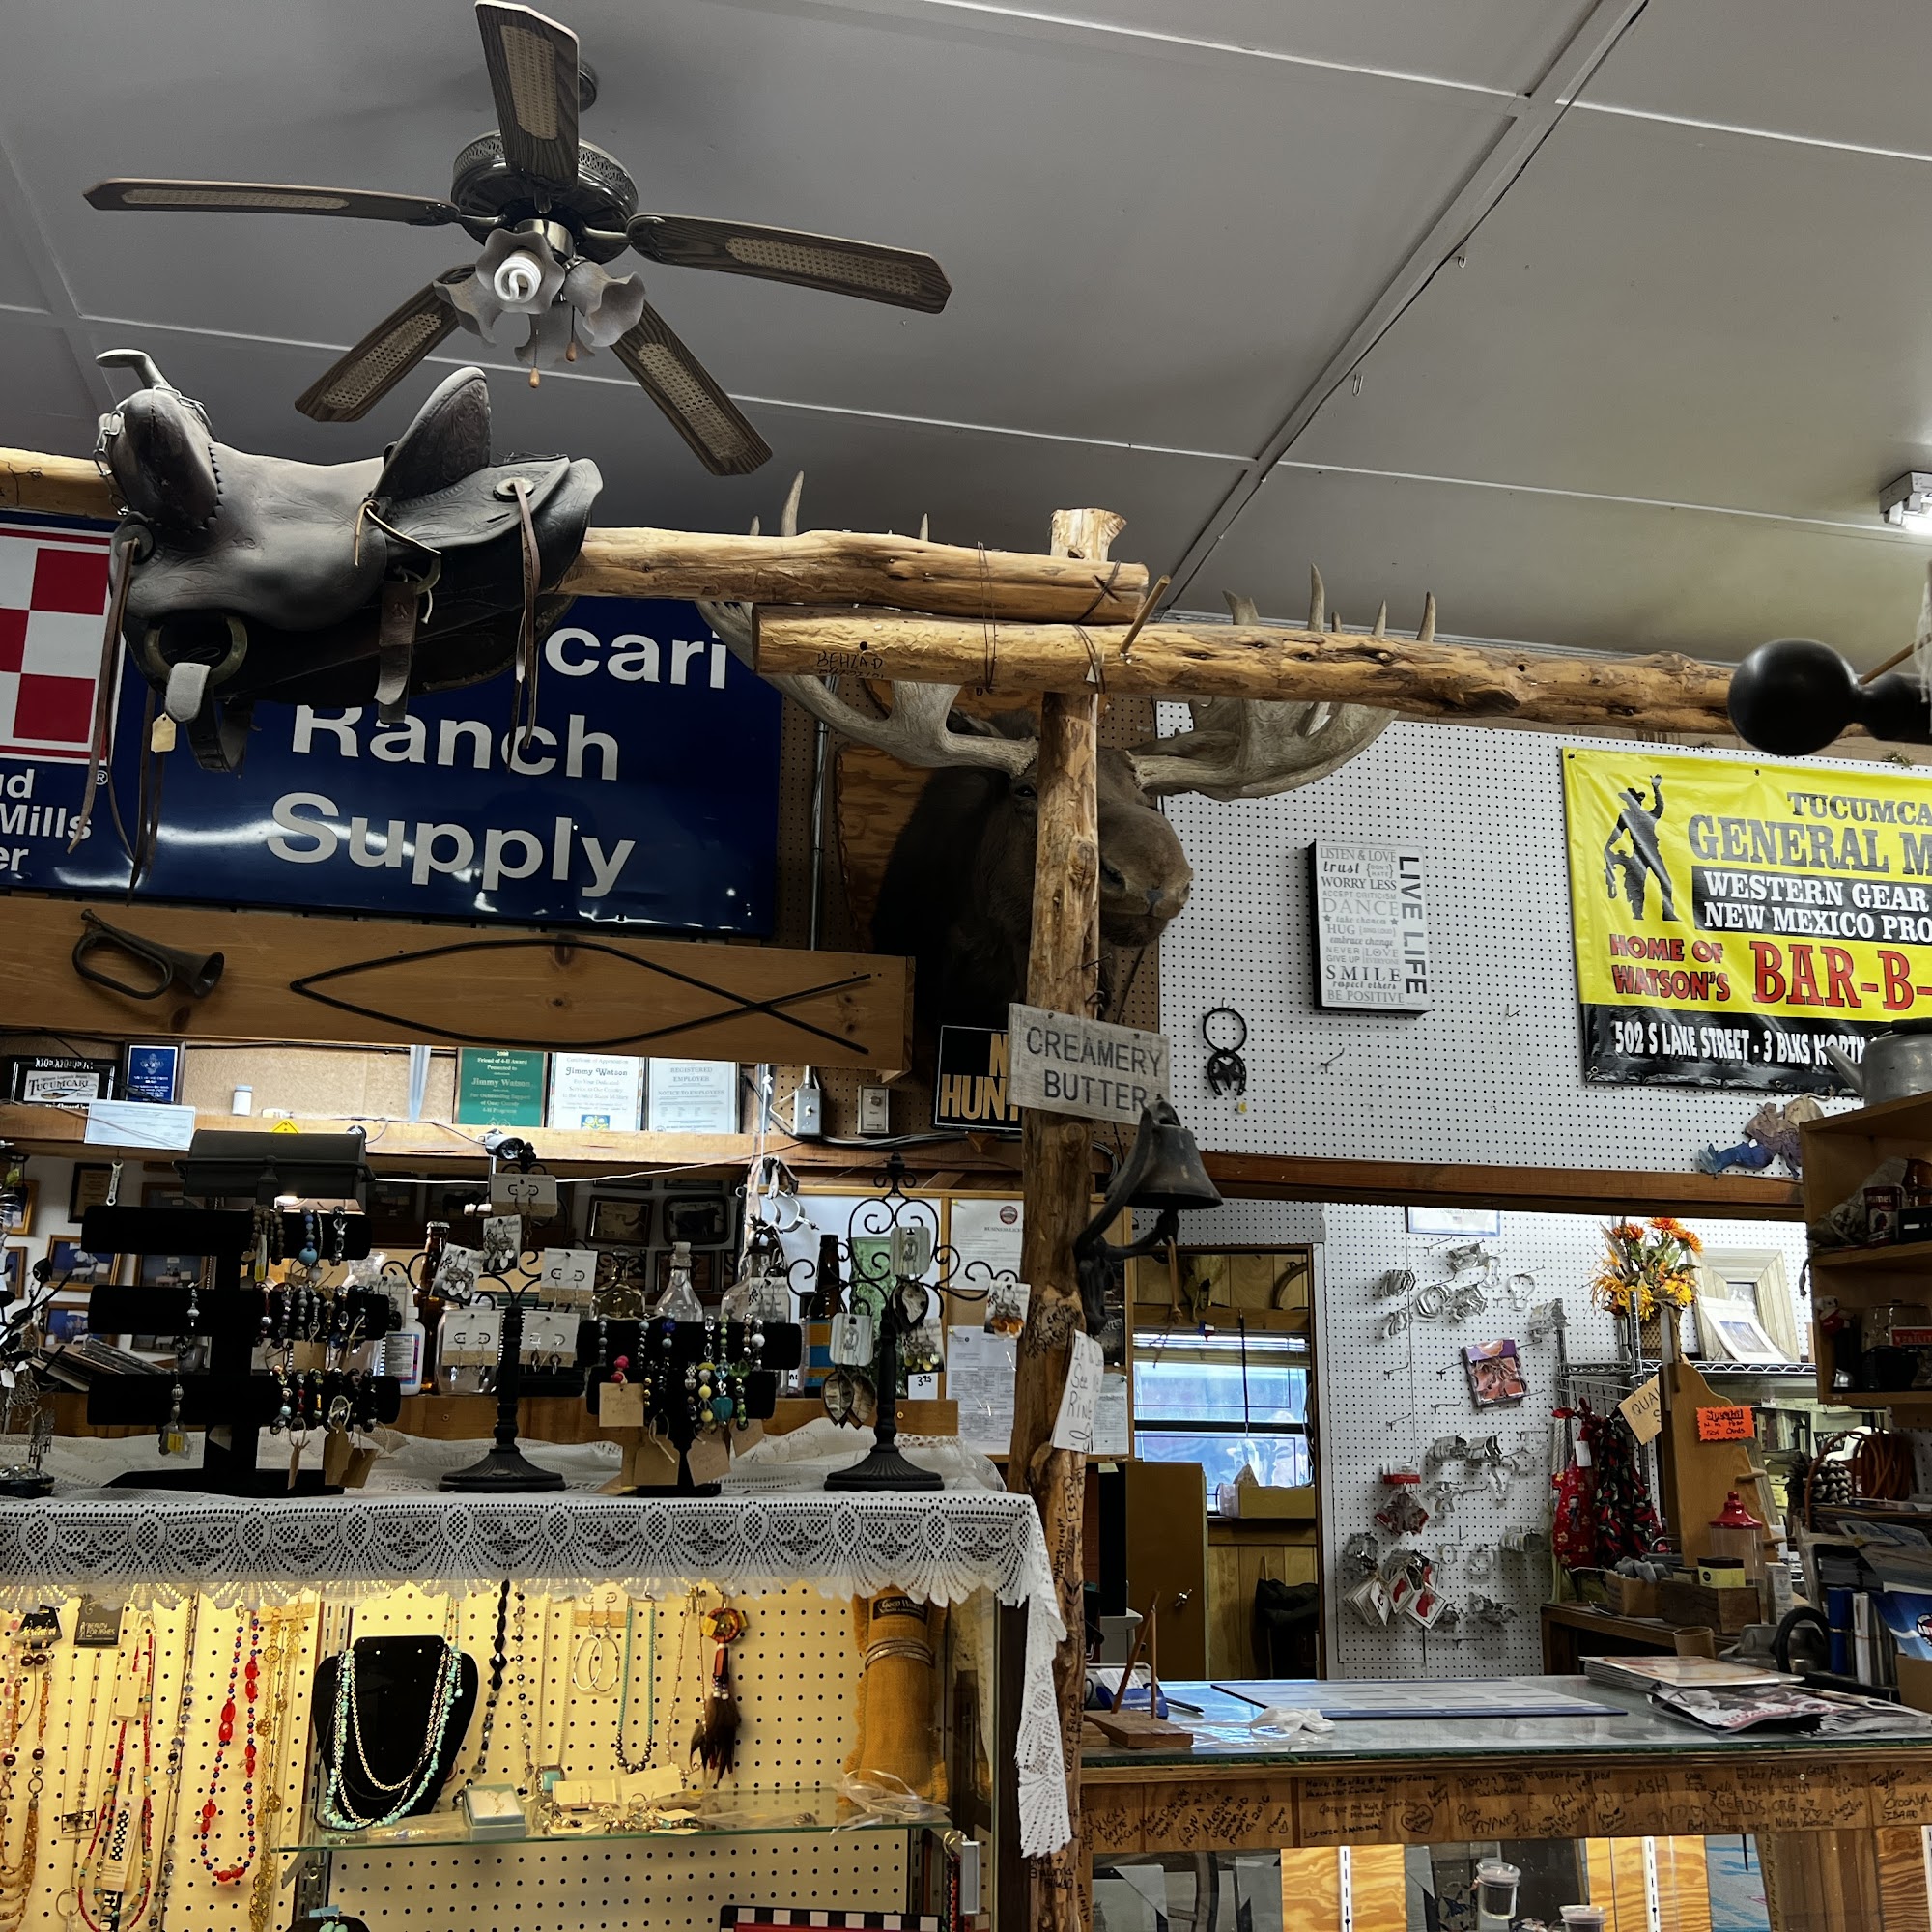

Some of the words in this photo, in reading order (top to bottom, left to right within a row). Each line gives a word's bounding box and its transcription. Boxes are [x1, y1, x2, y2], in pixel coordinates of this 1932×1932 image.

[545, 627, 728, 689] cari
[292, 704, 621, 781] Ranch
[1787, 792, 1932, 826] TUCUMCA
[268, 792, 636, 897] Supply
[1321, 848, 1354, 860] LISTEN
[1358, 850, 1366, 860] &
[1369, 850, 1396, 862] LOVE
[1688, 814, 1889, 873] GENERAL
[1321, 876, 1366, 889] WORRY
[1370, 879, 1397, 890] LESS
[1323, 861, 1359, 873] trust
[1399, 856, 1422, 919] LIVE
[1704, 870, 1843, 907] WESTERN
[1852, 883, 1930, 913] GEAR
[1321, 897, 1399, 916] DANCE
[1704, 901, 1763, 932] NEW
[1773, 907, 1874, 939] MEXICO
[1881, 915, 1932, 943] PRO
[1327, 924, 1355, 935] HUG
[1404, 932, 1427, 994] LIFE
[1609, 934, 1685, 962] HOME
[1692, 940, 1723, 964] OF
[1325, 964, 1402, 981] SMILE
[1611, 965, 1730, 1002] WATSON'S
[1327, 989, 1342, 1000] BE
[1347, 990, 1405, 1003] POSITIVE
[1027, 1026, 1162, 1077] CREAMERY
[1615, 1021, 1643, 1054] 502
[1649, 1022, 1657, 1055] S
[1662, 1023, 1698, 1057] LAKE
[1700, 1026, 1750, 1061] STREET
[1763, 1030, 1772, 1062] 3
[1776, 1032, 1810, 1063] BLKS
[471, 1078, 499, 1088] Jimmy
[565, 1066, 593, 1076] Jimmy
[595, 1067, 628, 1076] Watson
[1044, 1069, 1147, 1112] BUTTER
